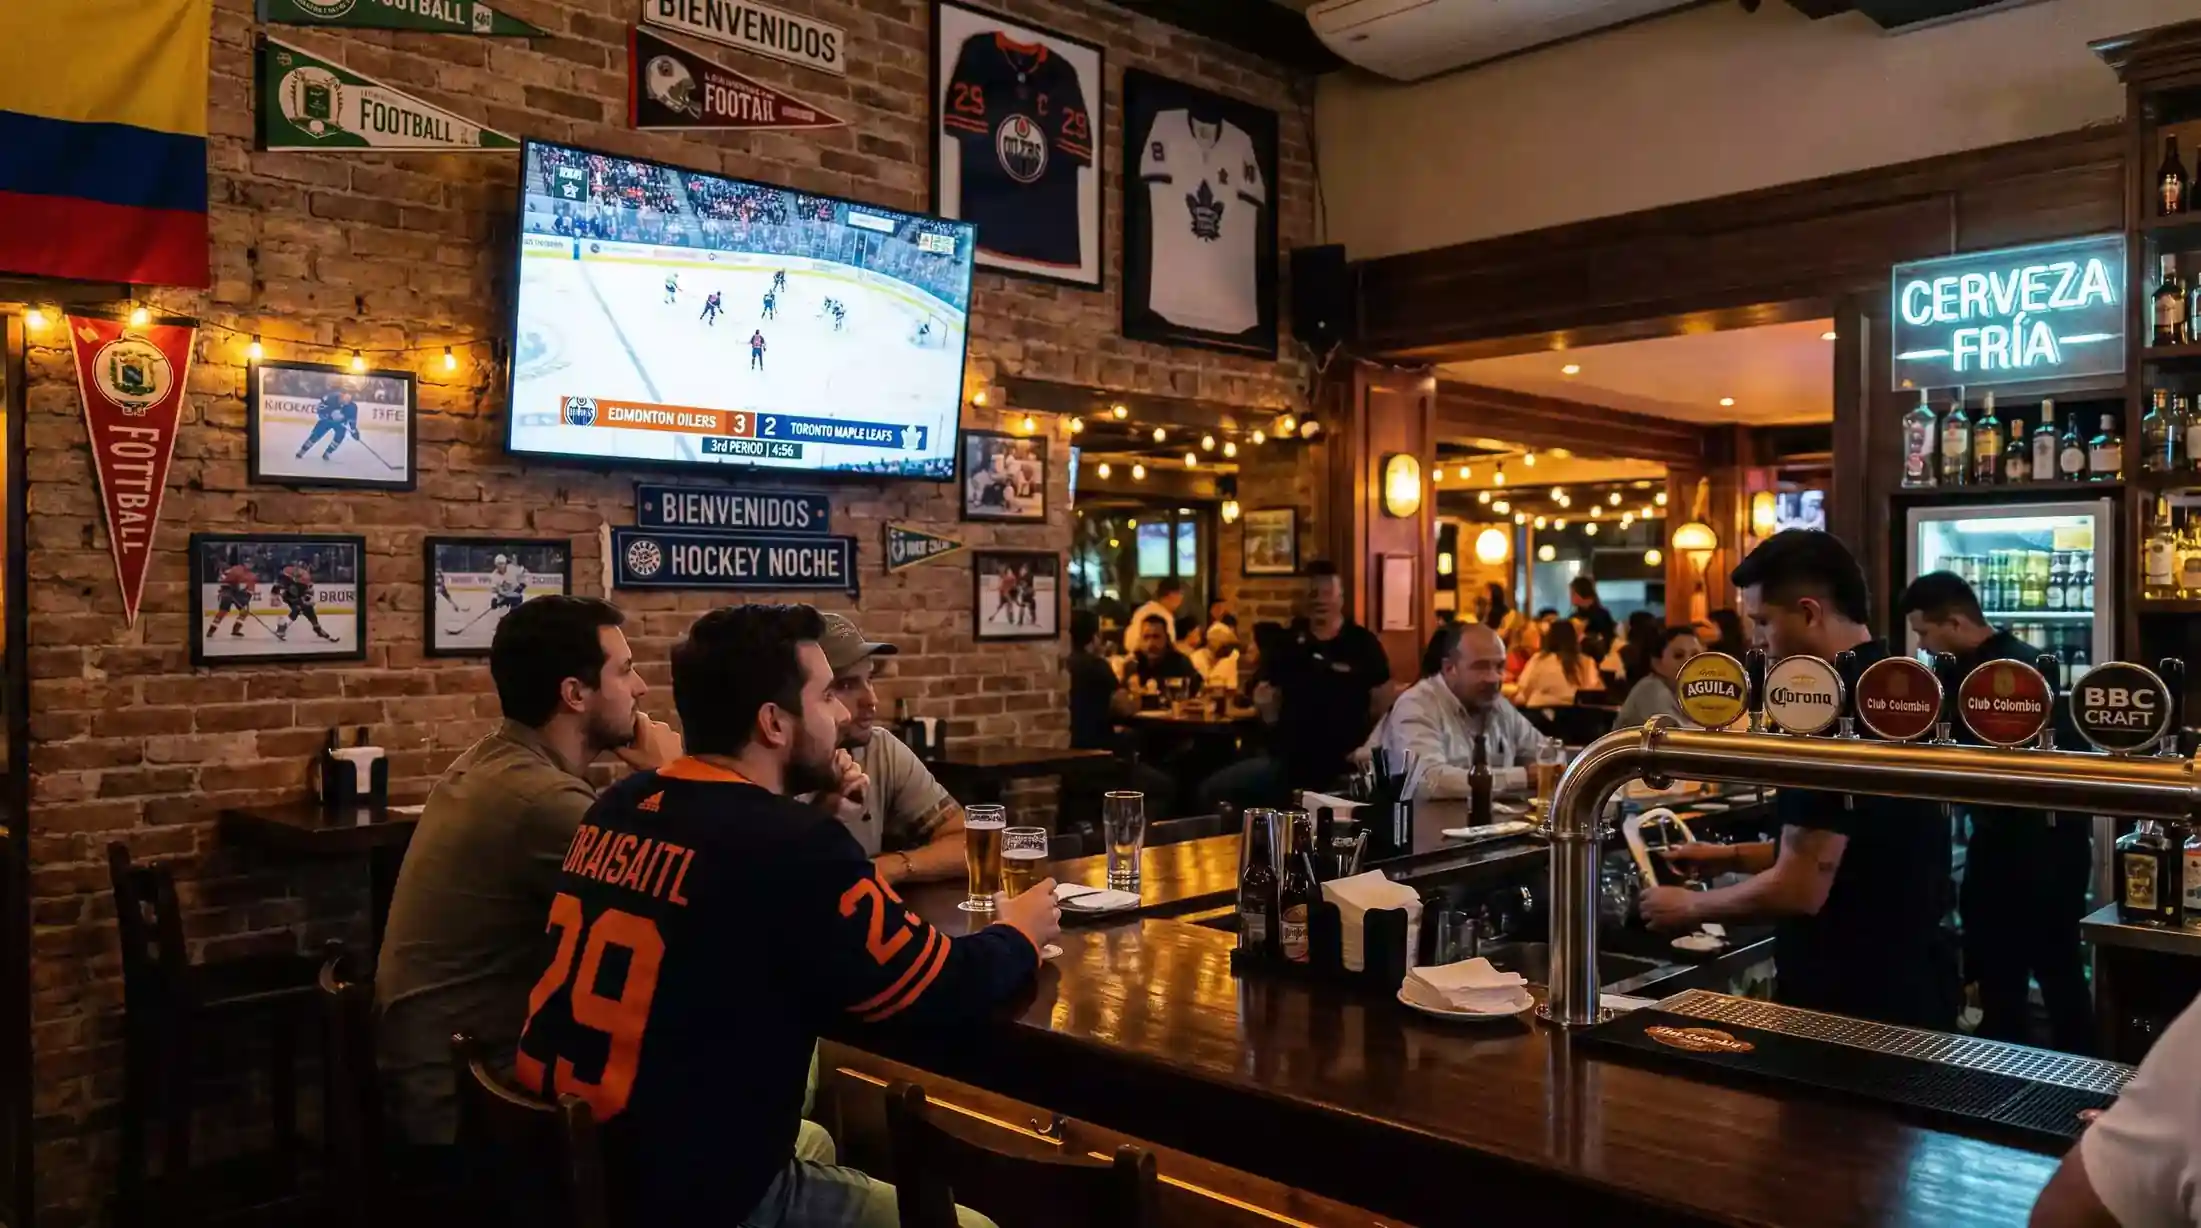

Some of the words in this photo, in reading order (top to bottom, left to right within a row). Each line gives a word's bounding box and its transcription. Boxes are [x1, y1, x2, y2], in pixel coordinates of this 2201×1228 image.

[954, 82, 985, 116] 29
[360, 97, 454, 143] FOOTBALL
[1061, 106, 1087, 139] 29
[1901, 258, 2115, 325] CERVEZA
[1953, 311, 2060, 372] FRÍA
[608, 407, 675, 425] EDMONTON
[677, 412, 717, 429] OILERS
[733, 414, 747, 434] 3
[764, 417, 777, 436] 2
[790, 422, 833, 437] TORONTO
[834, 425, 865, 440] MAPLE
[866, 428, 893, 442] LEAFS
[711, 439, 728, 453] 3rd
[729, 440, 764, 455] PERIOD
[772, 443, 794, 457] 4:56
[662, 493, 810, 528] BIENVENIDOS
[671, 545, 763, 577] HOCKEY
[768, 547, 841, 577] NOCHE
[1687, 681, 1736, 698] AGUILA
[1769, 687, 1837, 708] Corona
[1867, 698, 1886, 711] Club
[1968, 697, 1990, 711] Club
[1993, 698, 2042, 713] Colombia
[2084, 687, 2156, 709] BBC
[2084, 709, 2154, 726] CRAFT
[515, 892, 666, 1124] 29
